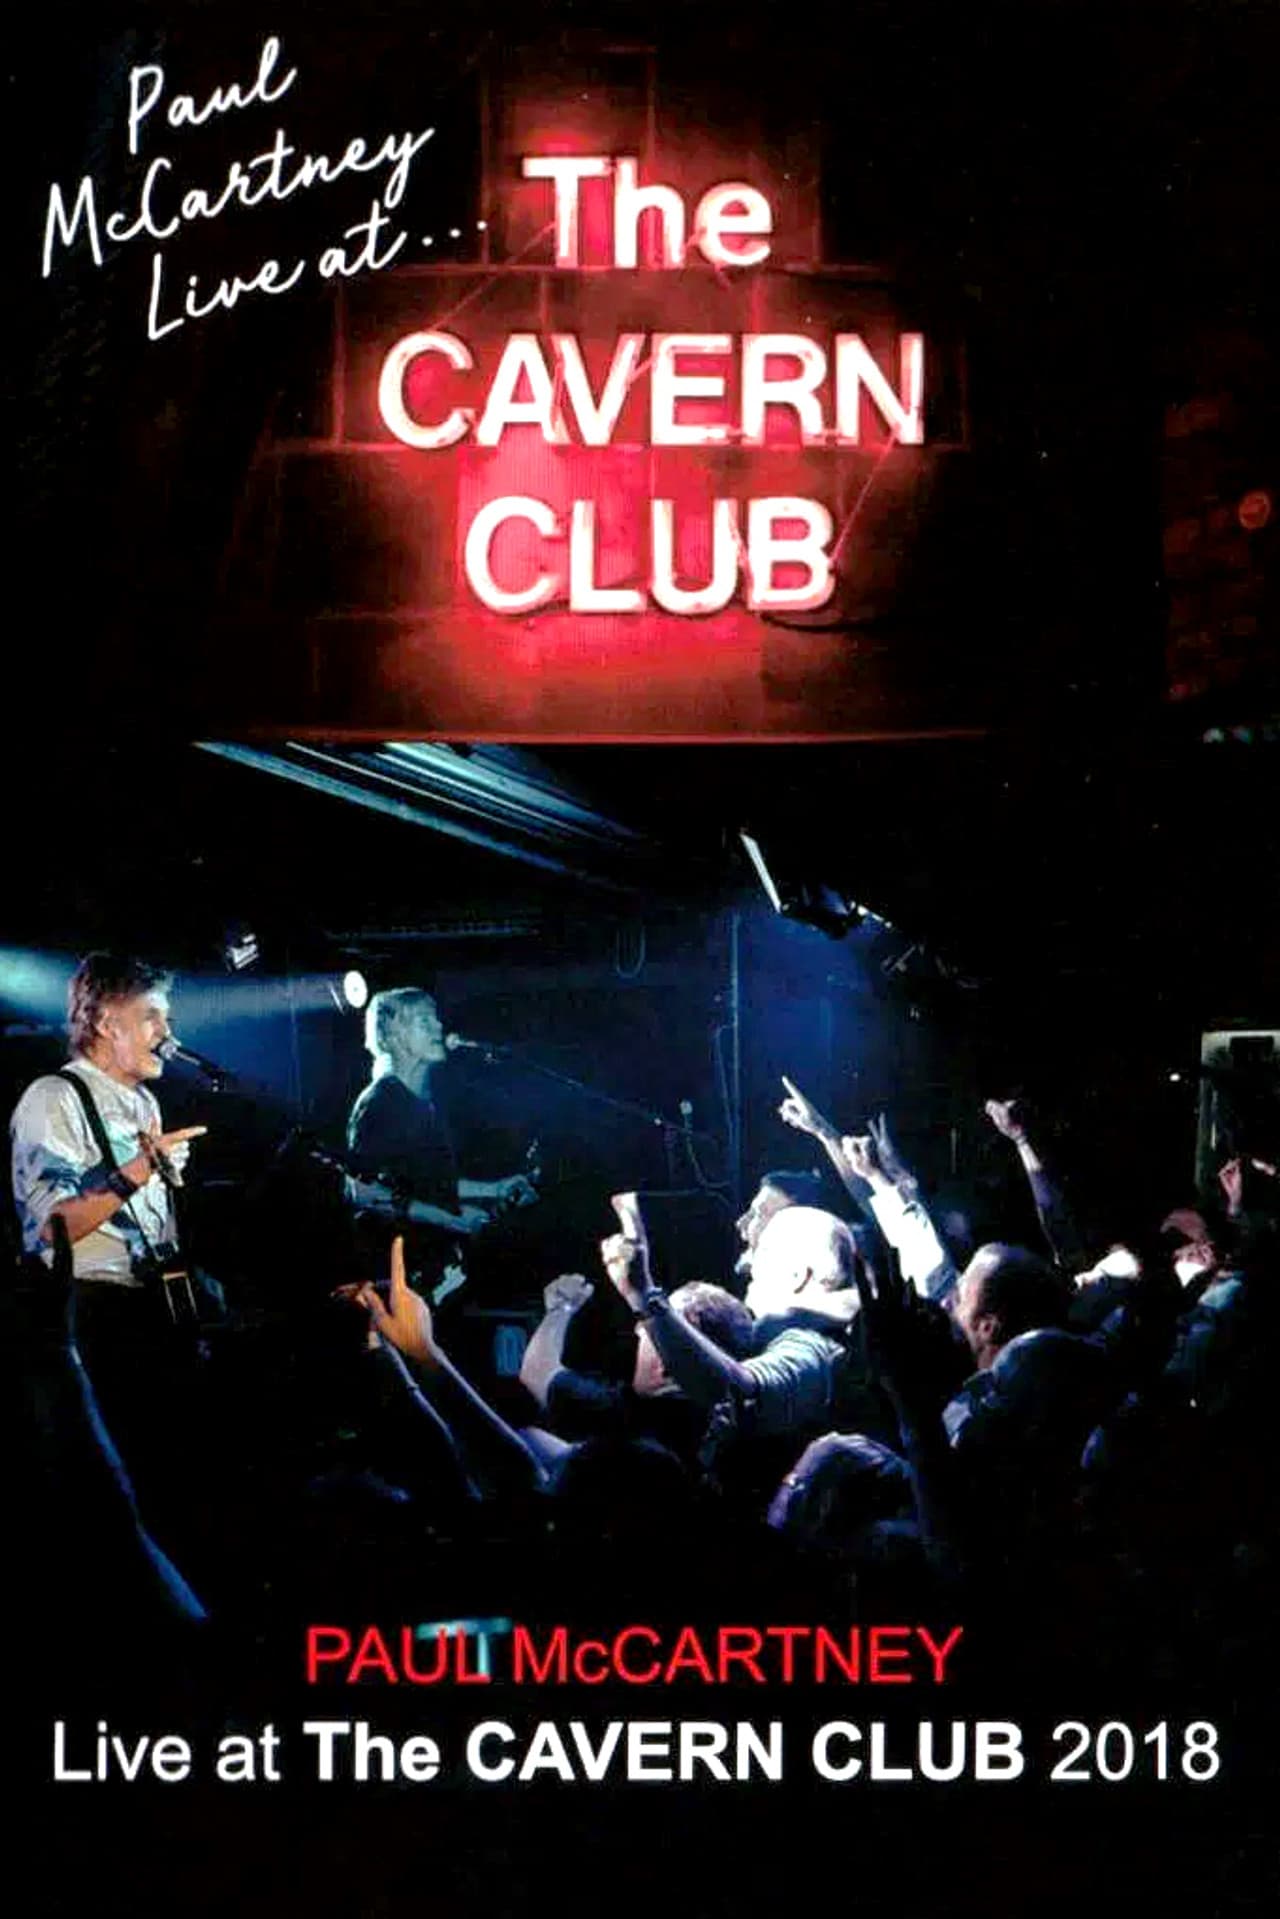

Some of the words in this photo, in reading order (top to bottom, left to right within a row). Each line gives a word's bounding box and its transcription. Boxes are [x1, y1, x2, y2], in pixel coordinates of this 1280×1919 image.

[522, 156, 773, 270] The
[377, 331, 924, 448] CAVERN
[464, 496, 835, 614] CLUB
